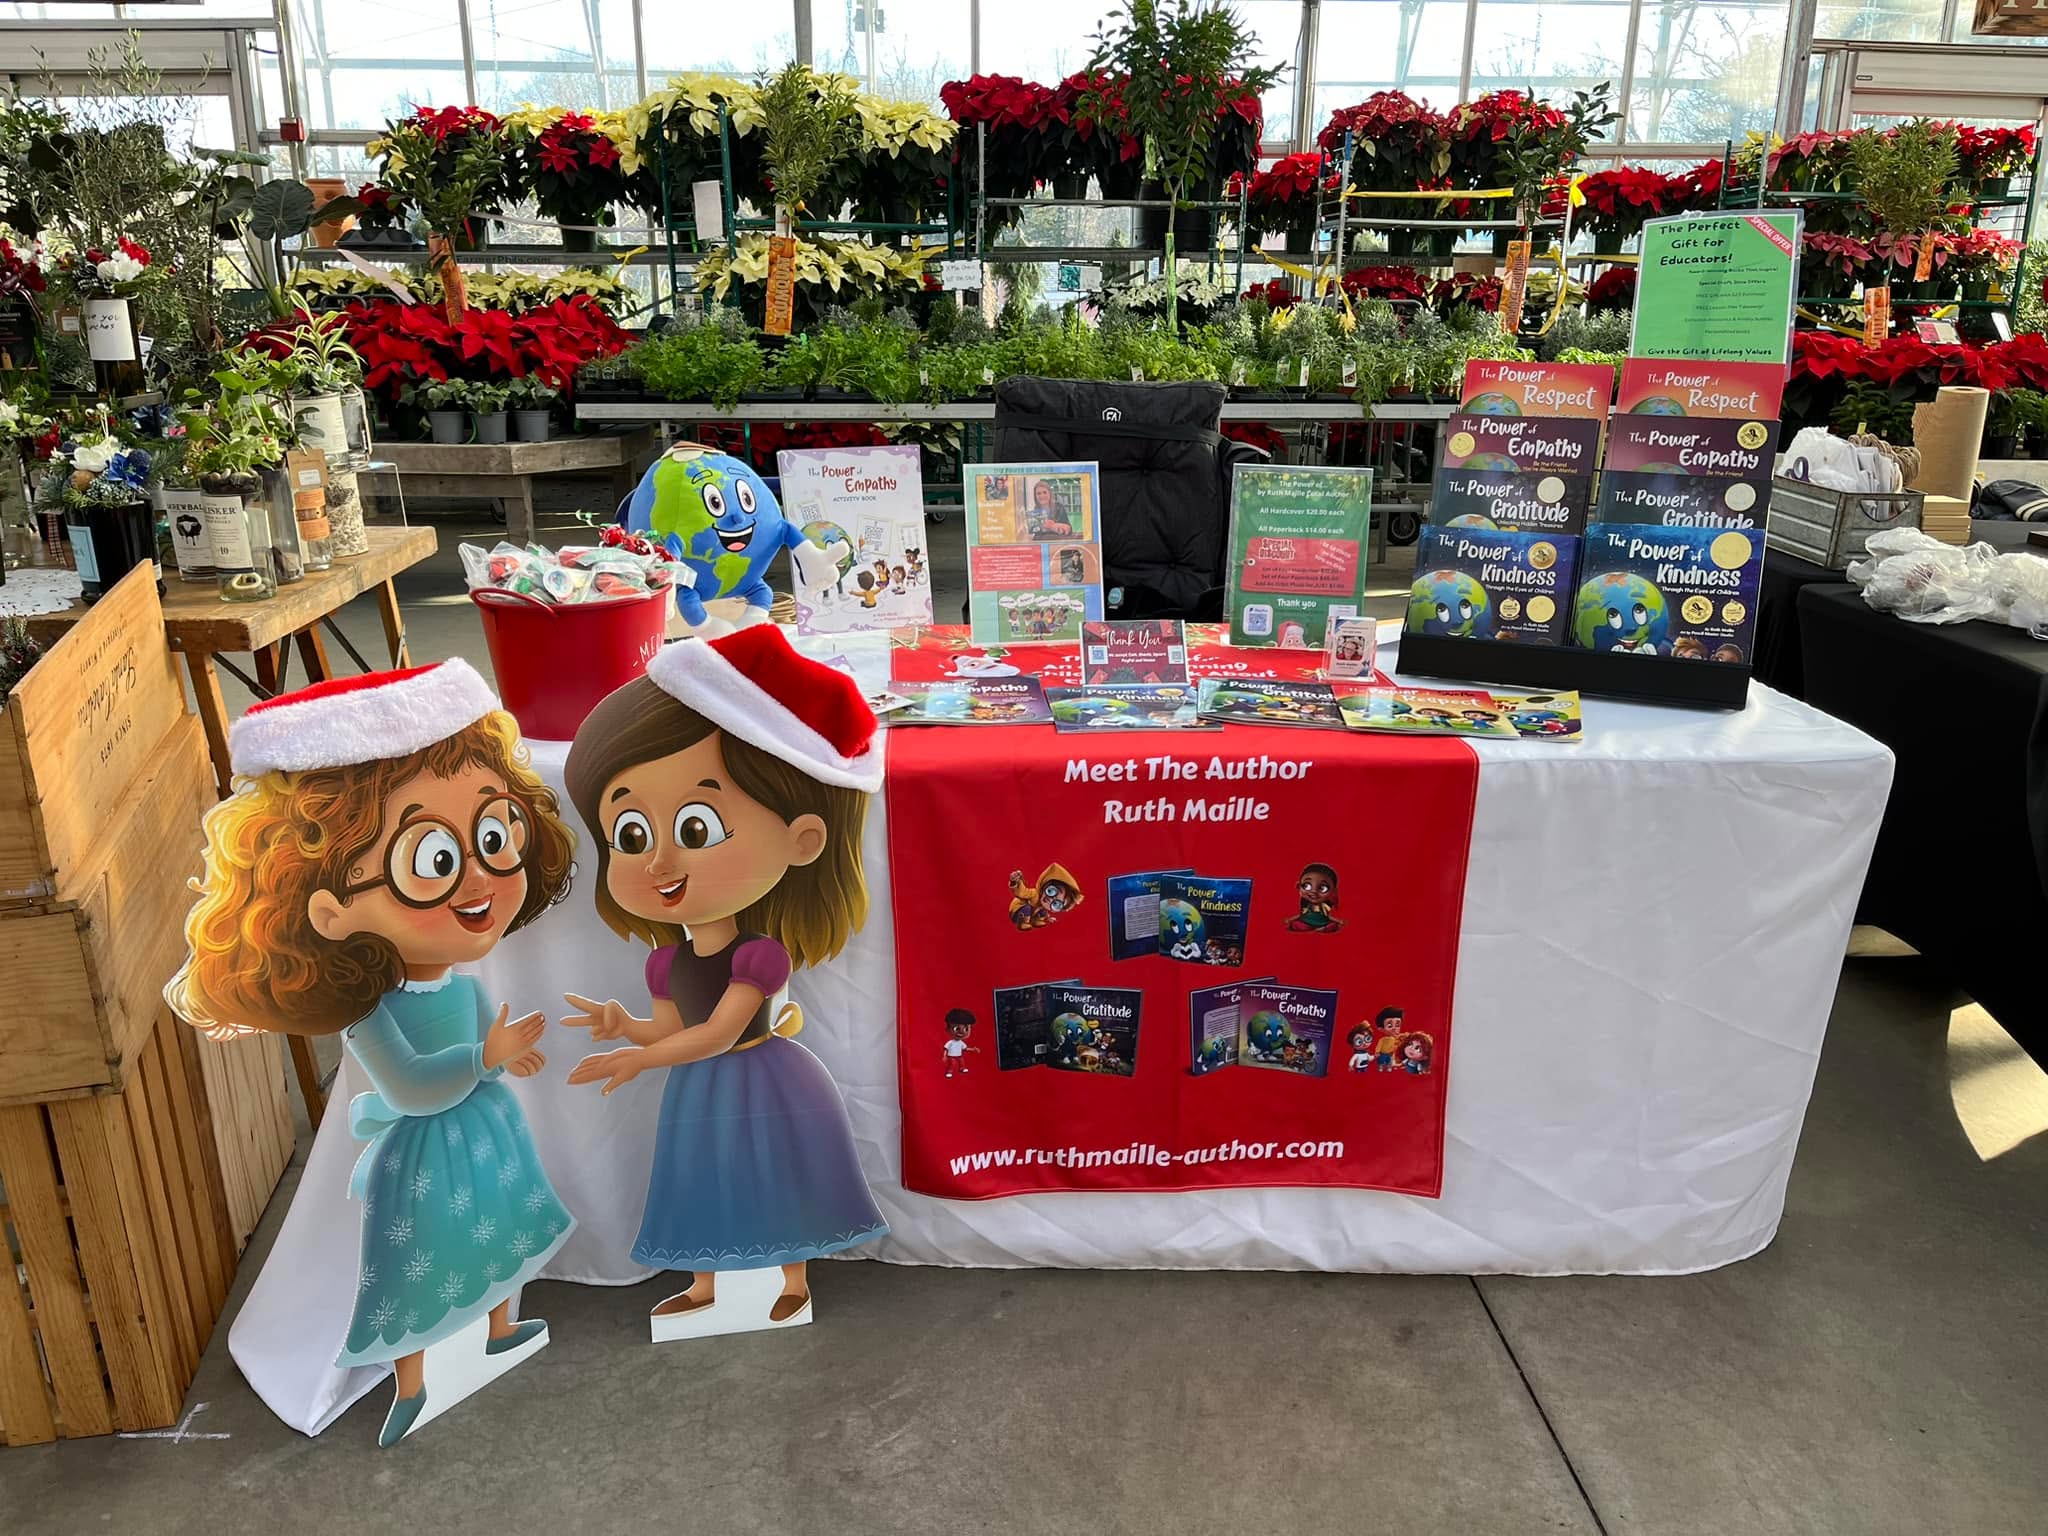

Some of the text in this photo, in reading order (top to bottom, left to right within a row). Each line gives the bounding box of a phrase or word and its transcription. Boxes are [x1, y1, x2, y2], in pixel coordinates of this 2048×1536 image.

[1660, 220, 1741, 235] The Perfect
[1750, 215, 1793, 251] SPECIAL OFFER
[1671, 237, 1725, 249] Gift for
[1660, 253, 1733, 266] Educators!
[775, 254, 791, 320] KUMQUAT
[1682, 348, 1700, 356] Gift
[1712, 347, 1743, 356] Lifelong
[1480, 368, 1496, 378] The
[1498, 366, 1546, 383] Power
[1647, 373, 1663, 384] The
[1665, 371, 1710, 387] Power
[1523, 385, 1597, 411] Respect
[1688, 389, 1759, 412] Respect
[1462, 418, 1539, 435] The Power of
[1629, 430, 1712, 447] The Power of
[1508, 437, 1582, 460] Empathy
[1679, 449, 1759, 470] Empathy
[808, 468, 820, 476] The
[821, 465, 856, 478] Power
[845, 476, 897, 493] Empathy
[1449, 479, 1525, 498] The Power of
[1615, 489, 1702, 507] The Power of
[1270, 507, 1305, 515] Hardcover
[1490, 498, 1570, 522] Gratitude
[1268, 525, 1304, 534] Paperback
[1261, 537, 1294, 549] SPECIAL
[1439, 534, 1455, 548] The
[1457, 539, 1511, 561] Power
[1511, 550, 1524, 562] of
[1607, 533, 1704, 562] The Power of
[1481, 563, 1557, 586] Kindness
[1656, 563, 1741, 587] Kindness
[1485, 584, 1505, 592] Through
[1662, 586, 1683, 594] Through
[1694, 587, 1708, 595] Eyes
[1716, 588, 1740, 596] Children
[1277, 598, 1317, 610] Thank you
[1105, 629, 1162, 649] Thank You
[1207, 669, 1278, 678] About
[953, 684, 1029, 694] Empathy
[1087, 688, 1138, 696] Power
[1229, 681, 1276, 690] Power
[1262, 688, 1334, 700] Gratitud
[1400, 693, 1481, 706] Respect
[1064, 755, 1313, 783] Meet The Author
[1103, 796, 1270, 824] Ruth Maille
[1187, 886, 1216, 898] Power
[1200, 900, 1242, 912] Kindness
[1063, 992, 1092, 1003] Power
[1260, 989, 1291, 1001] Power
[1082, 1003, 1132, 1018] Gratitude
[1278, 1001, 1327, 1018] Empathy
[950, 1139, 1344, 1177] www.ruthmaille-author.com
